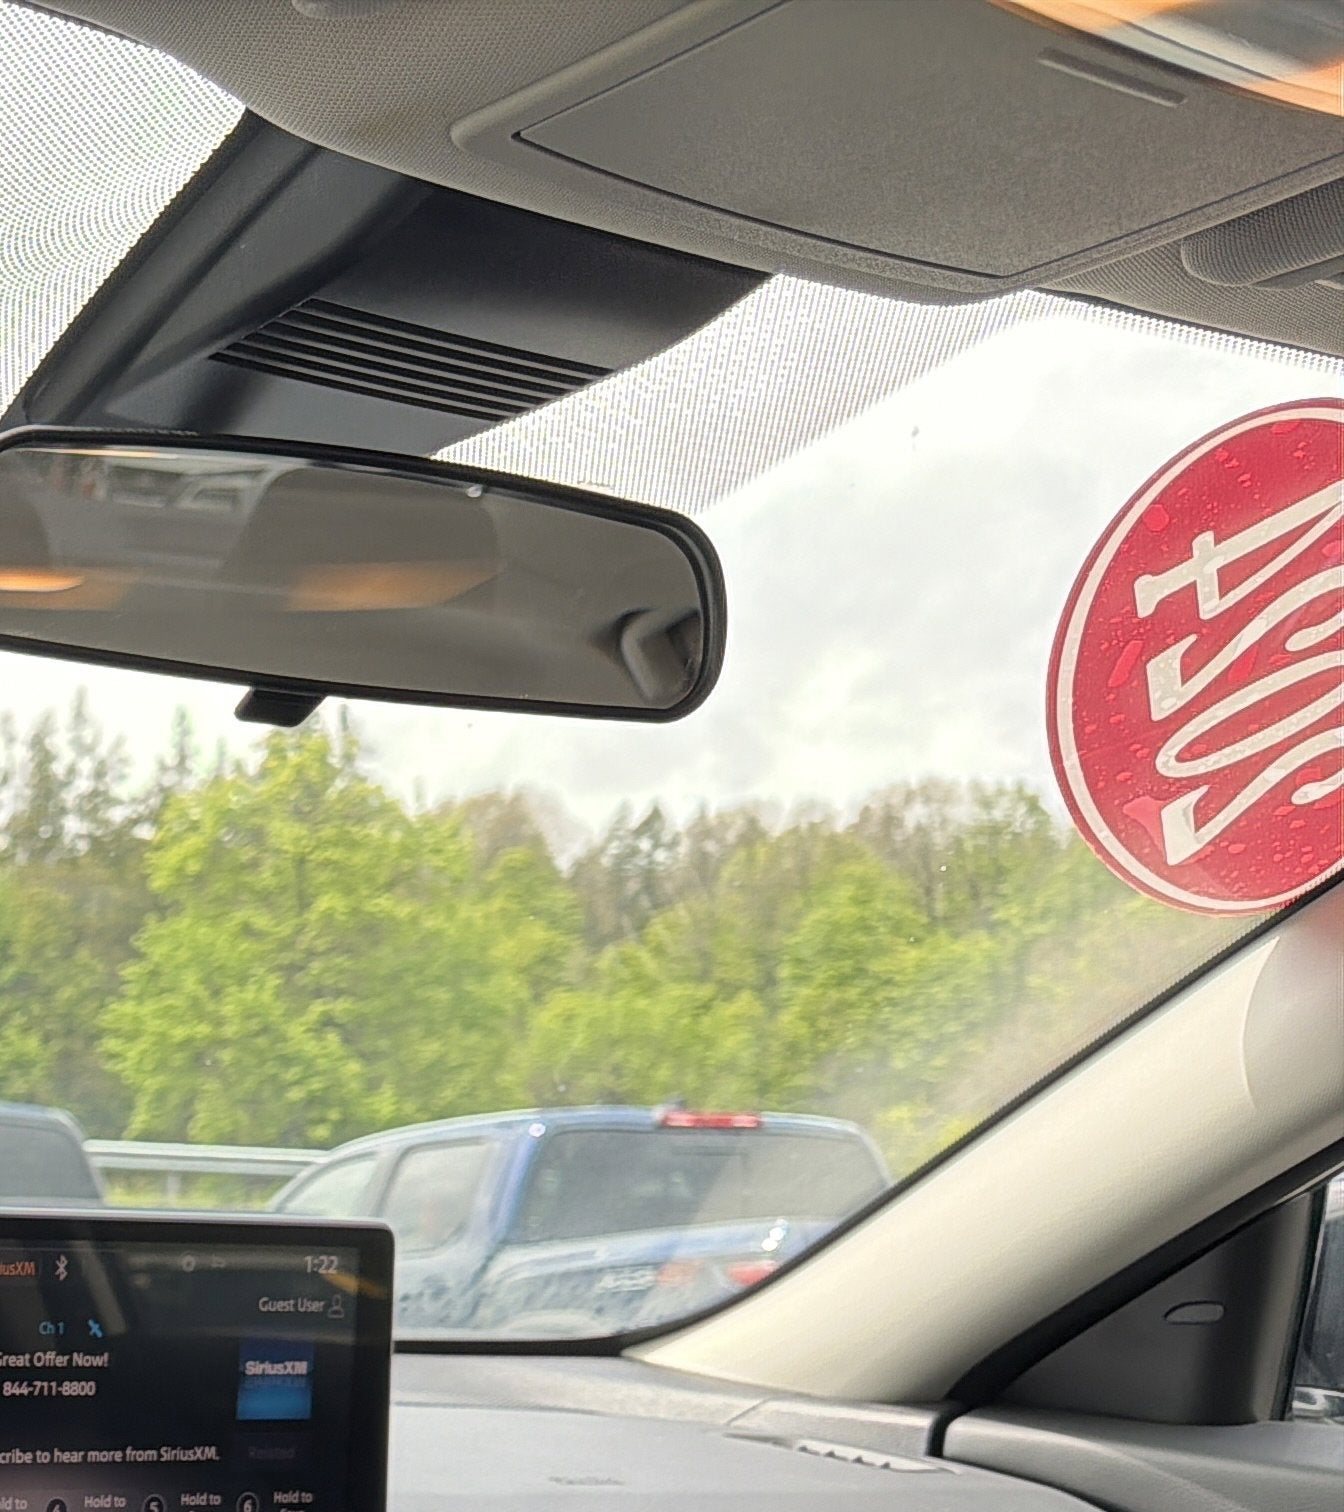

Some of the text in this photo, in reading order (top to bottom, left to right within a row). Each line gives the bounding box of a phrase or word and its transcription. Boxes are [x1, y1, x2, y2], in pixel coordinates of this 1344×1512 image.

[304, 1255, 339, 1274] 1:22
[258, 1298, 325, 1313] Guest User
[38, 1321, 55, 1335] Ch
[33, 1351, 69, 1368] Offer
[72, 1351, 109, 1368] Now!
[244, 1360, 308, 1376] SiriusXM
[2, 1381, 96, 1397] 844-711-8800
[36, 1448, 50, 1463] to
[53, 1447, 84, 1464] hear
[87, 1449, 123, 1463] more
[125, 1445, 158, 1462] from
[159, 1445, 220, 1462] SiriusXM.
[14, 1497, 27, 1511] to
[84, 1494, 126, 1508] Hold to
[180, 1492, 221, 1506] Hold to
[273, 1490, 313, 1504] Hold to
